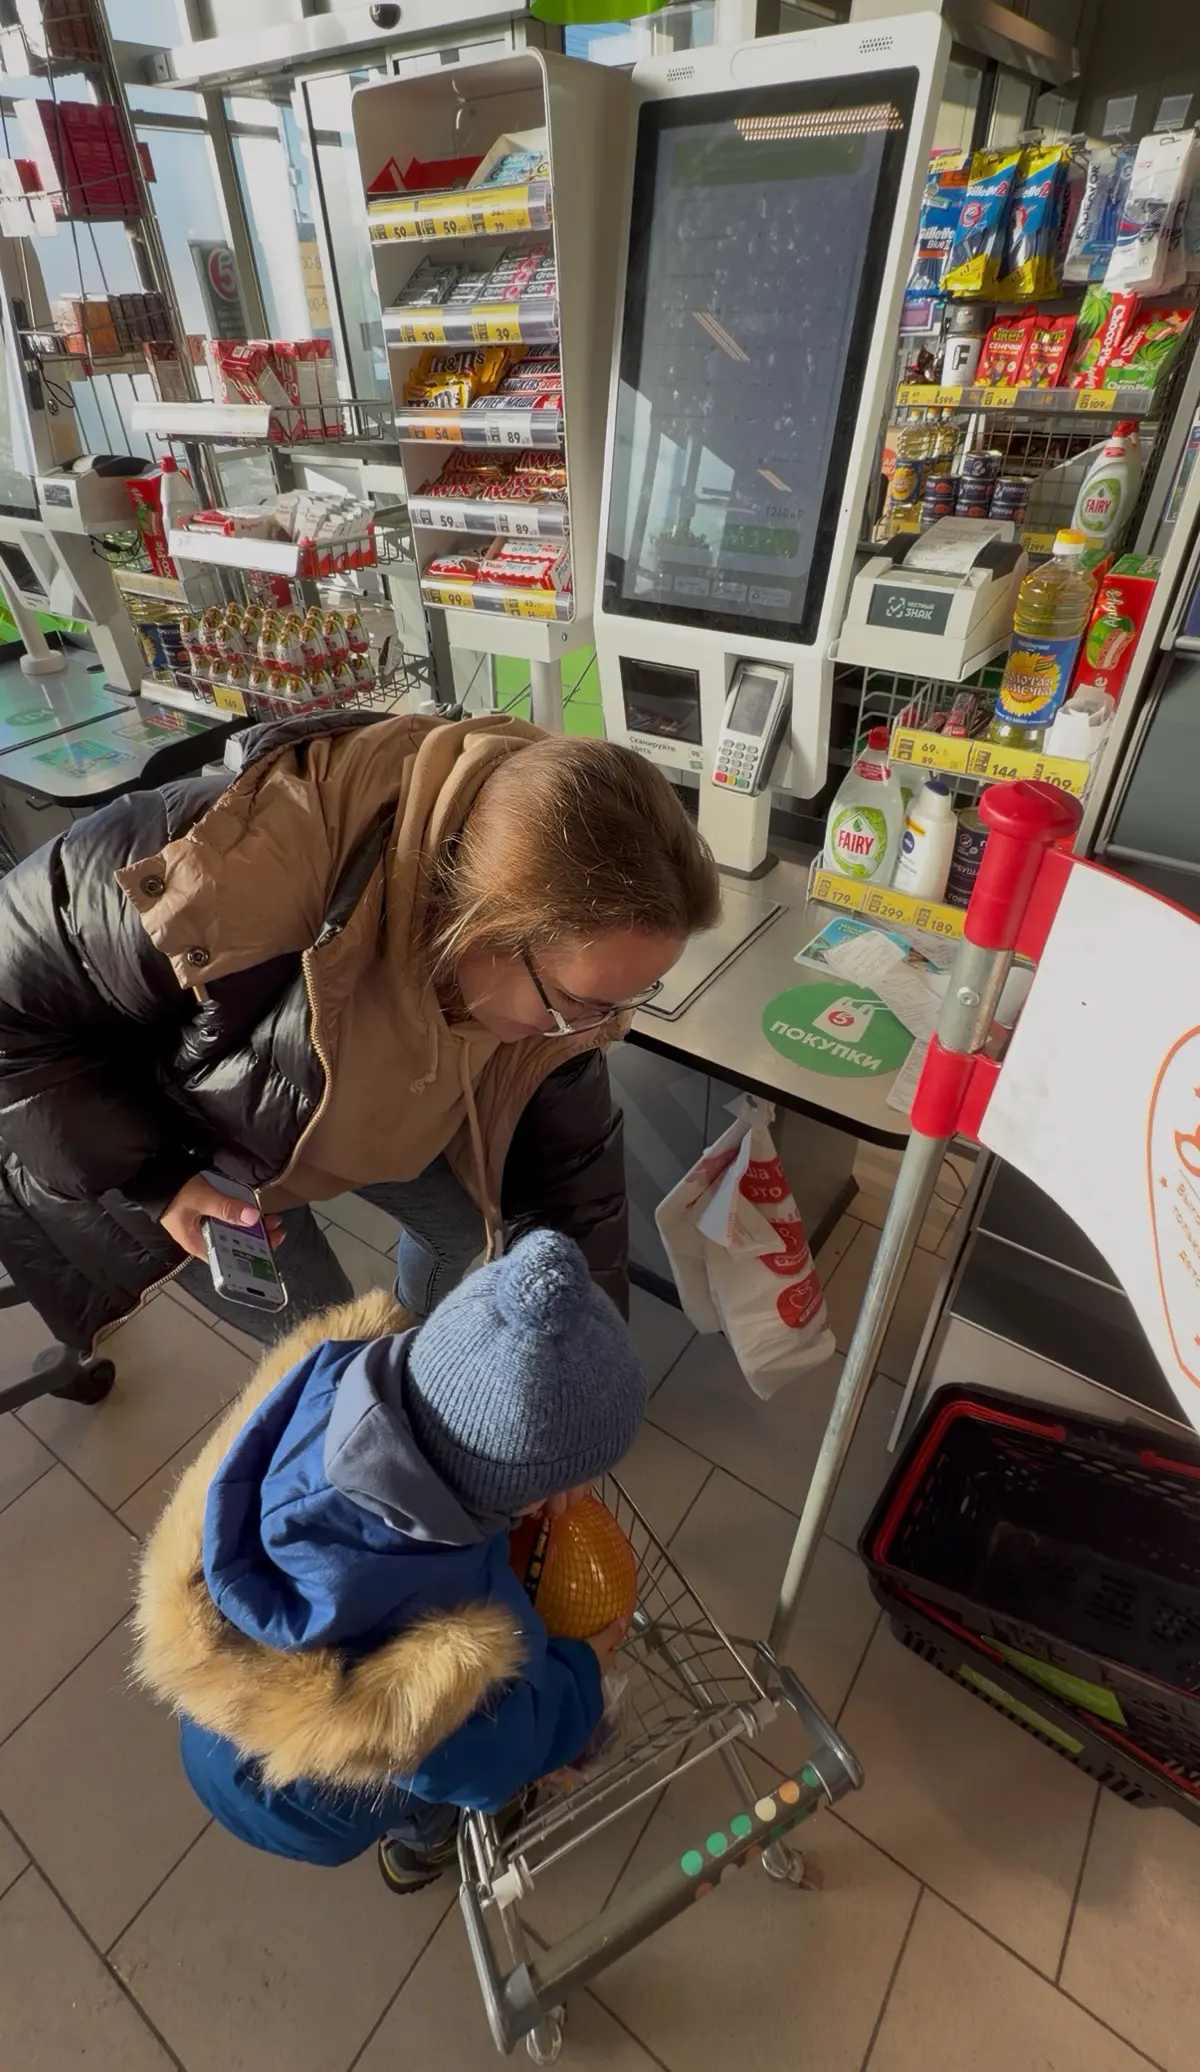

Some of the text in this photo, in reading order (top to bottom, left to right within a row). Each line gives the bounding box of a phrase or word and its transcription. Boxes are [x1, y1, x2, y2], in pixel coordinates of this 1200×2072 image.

[443, 220, 457, 234] 59
[920, 227, 955, 240] Gillette
[495, 328, 510, 341] 39
[507, 431, 521, 443] 89
[1085, 498, 1112, 514] FAIRY
[440, 515, 454, 528] 59
[515, 524, 529, 535] 89
[447, 594, 462, 606] 99
[905, 608, 933, 620] ЗНАК
[629, 736, 676, 753] Сканируйте
[921, 743, 936, 753] 69
[837, 829, 875, 856] FAIRY
[832, 890, 851, 905] 179
[879, 904, 904, 920] 299
[931, 919, 953, 934] 189
[832, 1012, 853, 1026] 5
[769, 1020, 882, 1072] ПОКУПКИ
